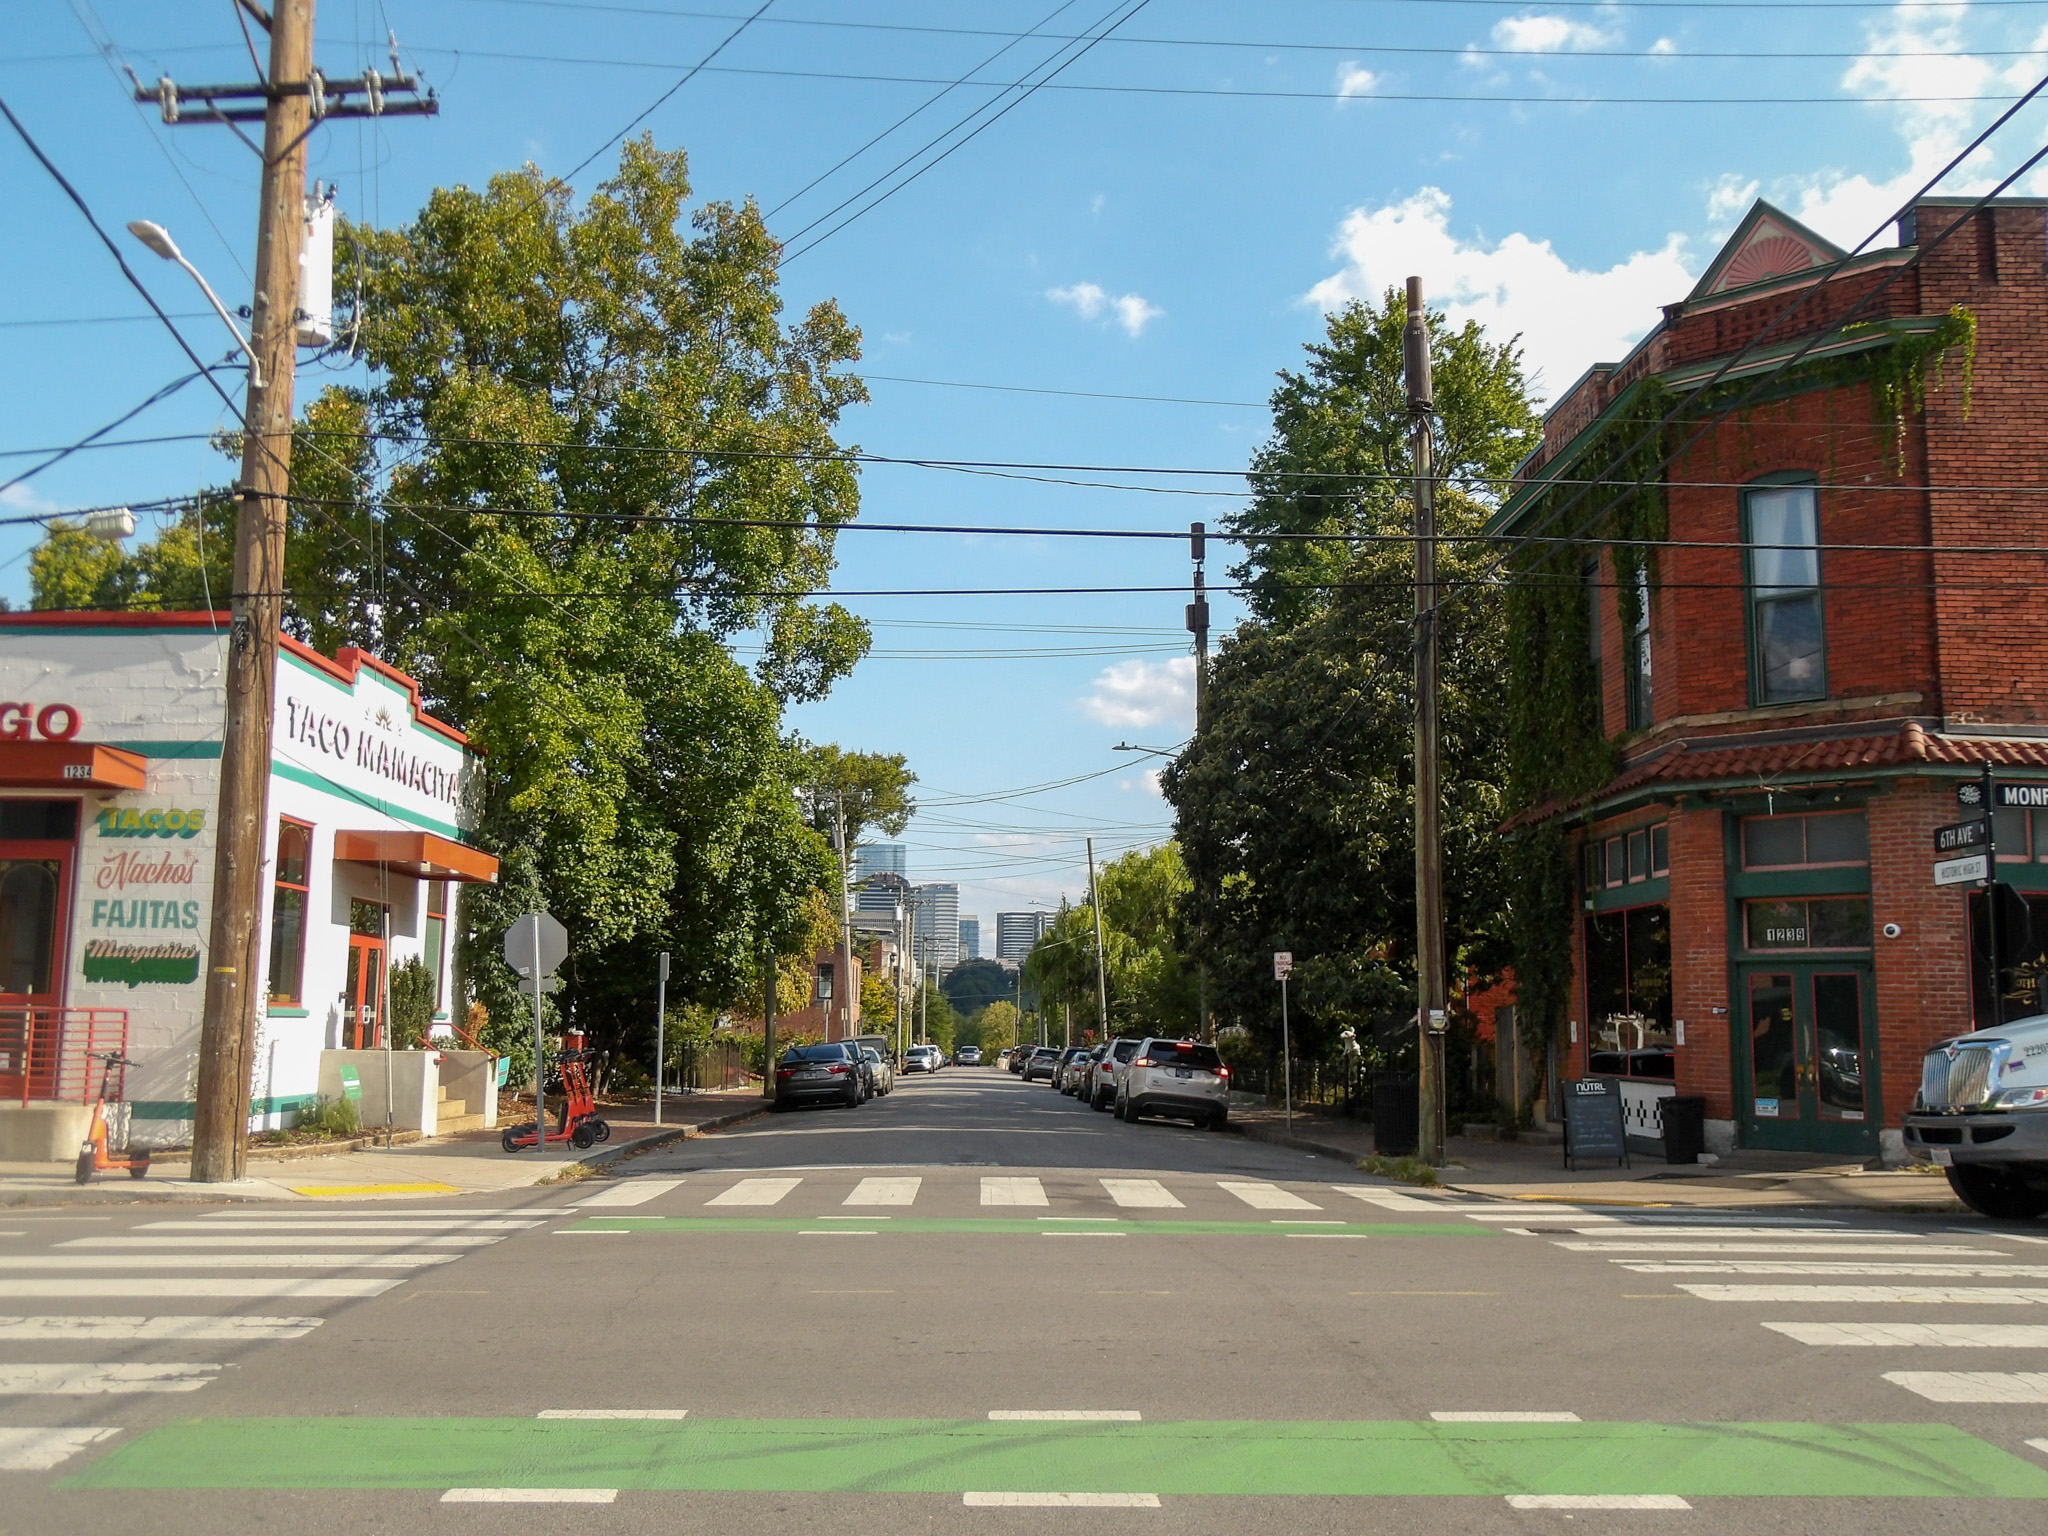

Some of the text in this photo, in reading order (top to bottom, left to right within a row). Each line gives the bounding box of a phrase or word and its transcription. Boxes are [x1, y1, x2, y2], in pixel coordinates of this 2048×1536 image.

[287, 696, 459, 806] TACO MAMACITA
[66, 766, 92, 778] 1234
[101, 808, 206, 834] TACOS
[1940, 829, 1955, 849] 6TH
[1957, 825, 1973, 845] AVE
[97, 850, 199, 891] Nachos
[1941, 865, 1962, 879] HISTORIC
[92, 900, 199, 929] FAJITAS
[1767, 928, 1805, 941] 1239
[86, 939, 199, 964] Margaritas
